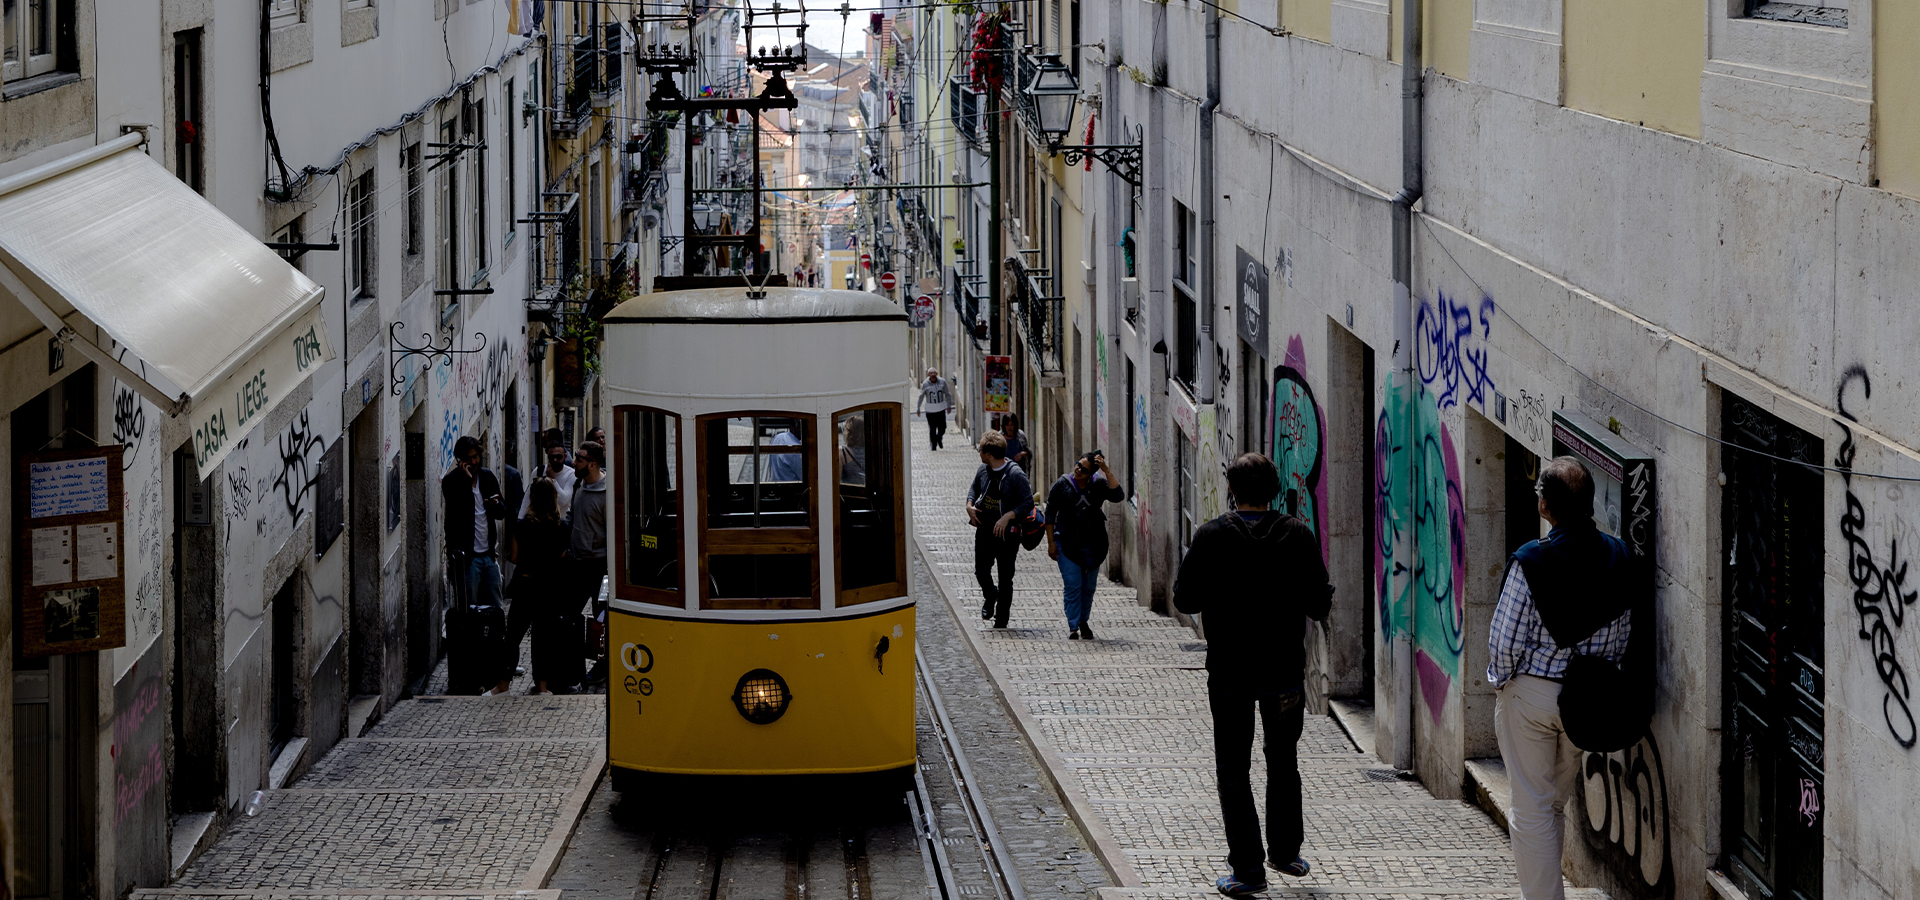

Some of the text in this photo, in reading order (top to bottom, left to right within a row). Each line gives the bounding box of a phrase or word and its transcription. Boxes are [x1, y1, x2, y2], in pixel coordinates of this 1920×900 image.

[293, 325, 322, 373] TOFA
[195, 408, 229, 468] CASA
[236, 368, 269, 428] LIEGE
[636, 700, 642, 715] 1
